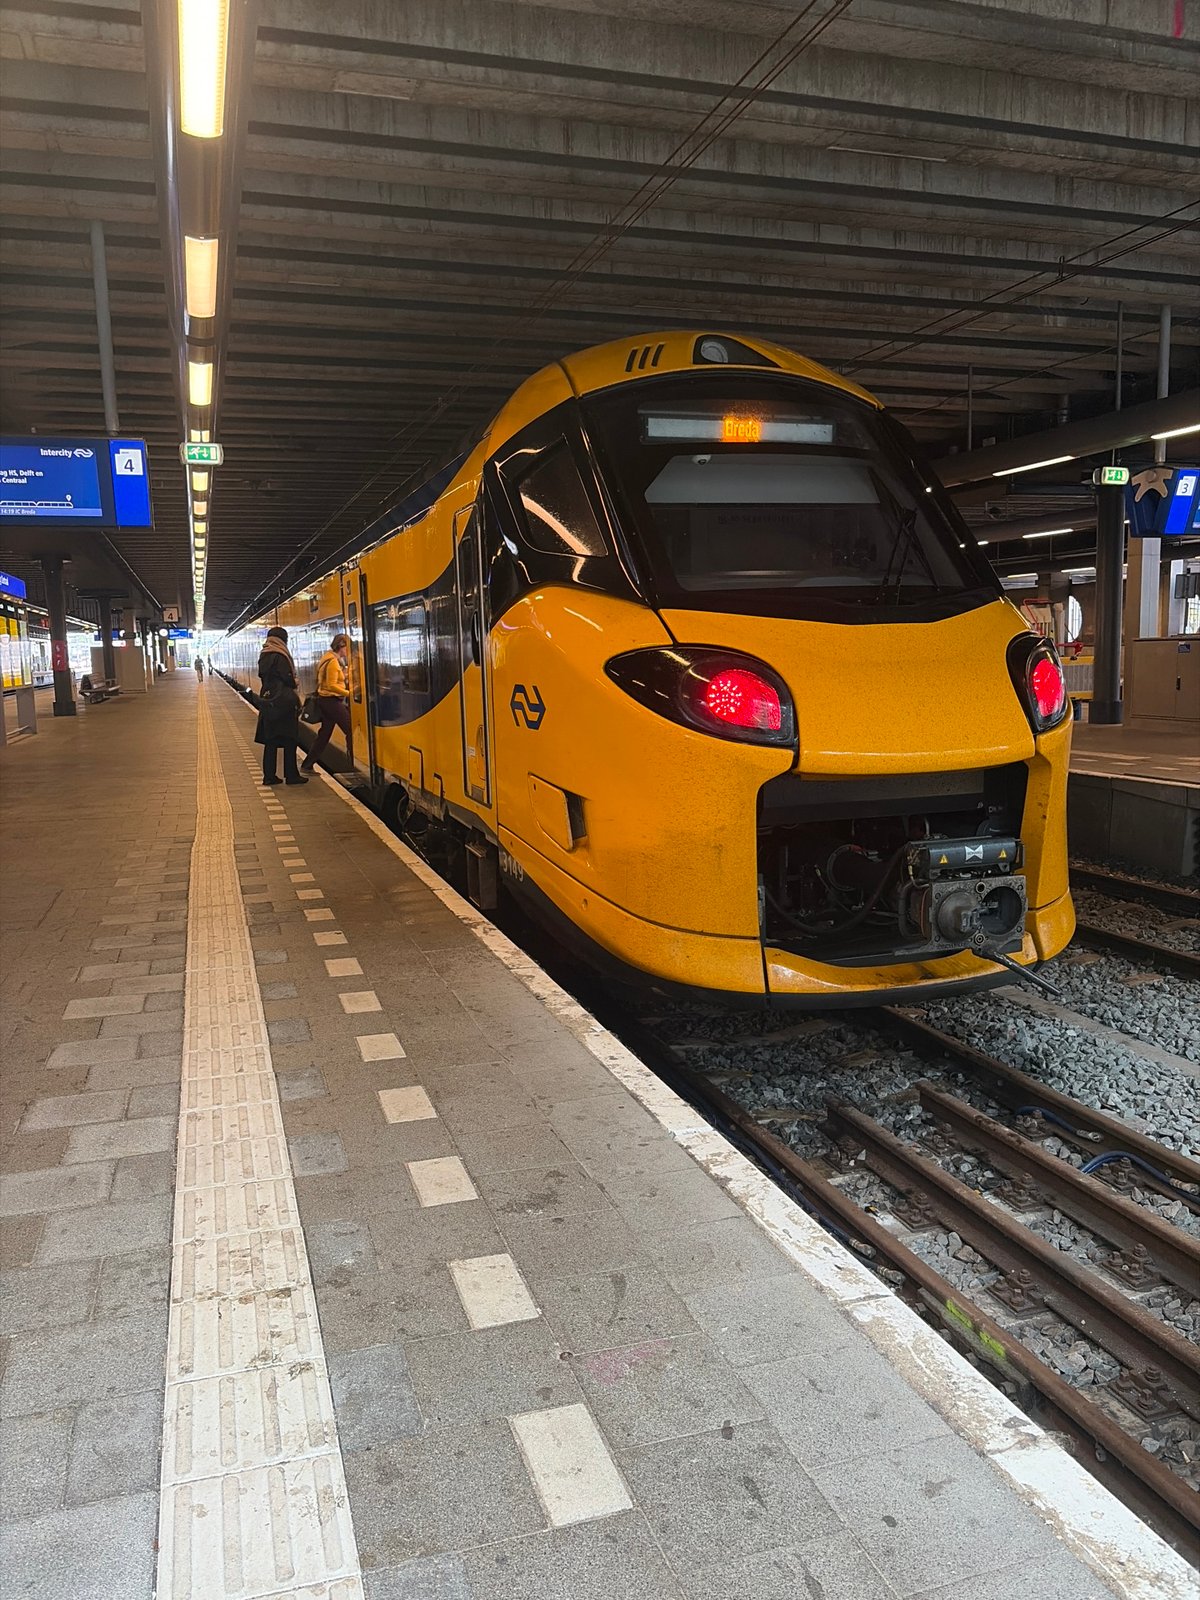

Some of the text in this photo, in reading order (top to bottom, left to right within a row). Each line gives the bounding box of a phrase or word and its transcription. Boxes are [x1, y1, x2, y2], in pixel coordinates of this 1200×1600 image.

[725, 420, 759, 438] Breda
[40, 448, 72, 458] Intercity
[124, 459, 134, 473] 4
[1181, 483, 1189, 494] 3
[167, 612, 174, 621] 4
[502, 851, 524, 882] 3149
